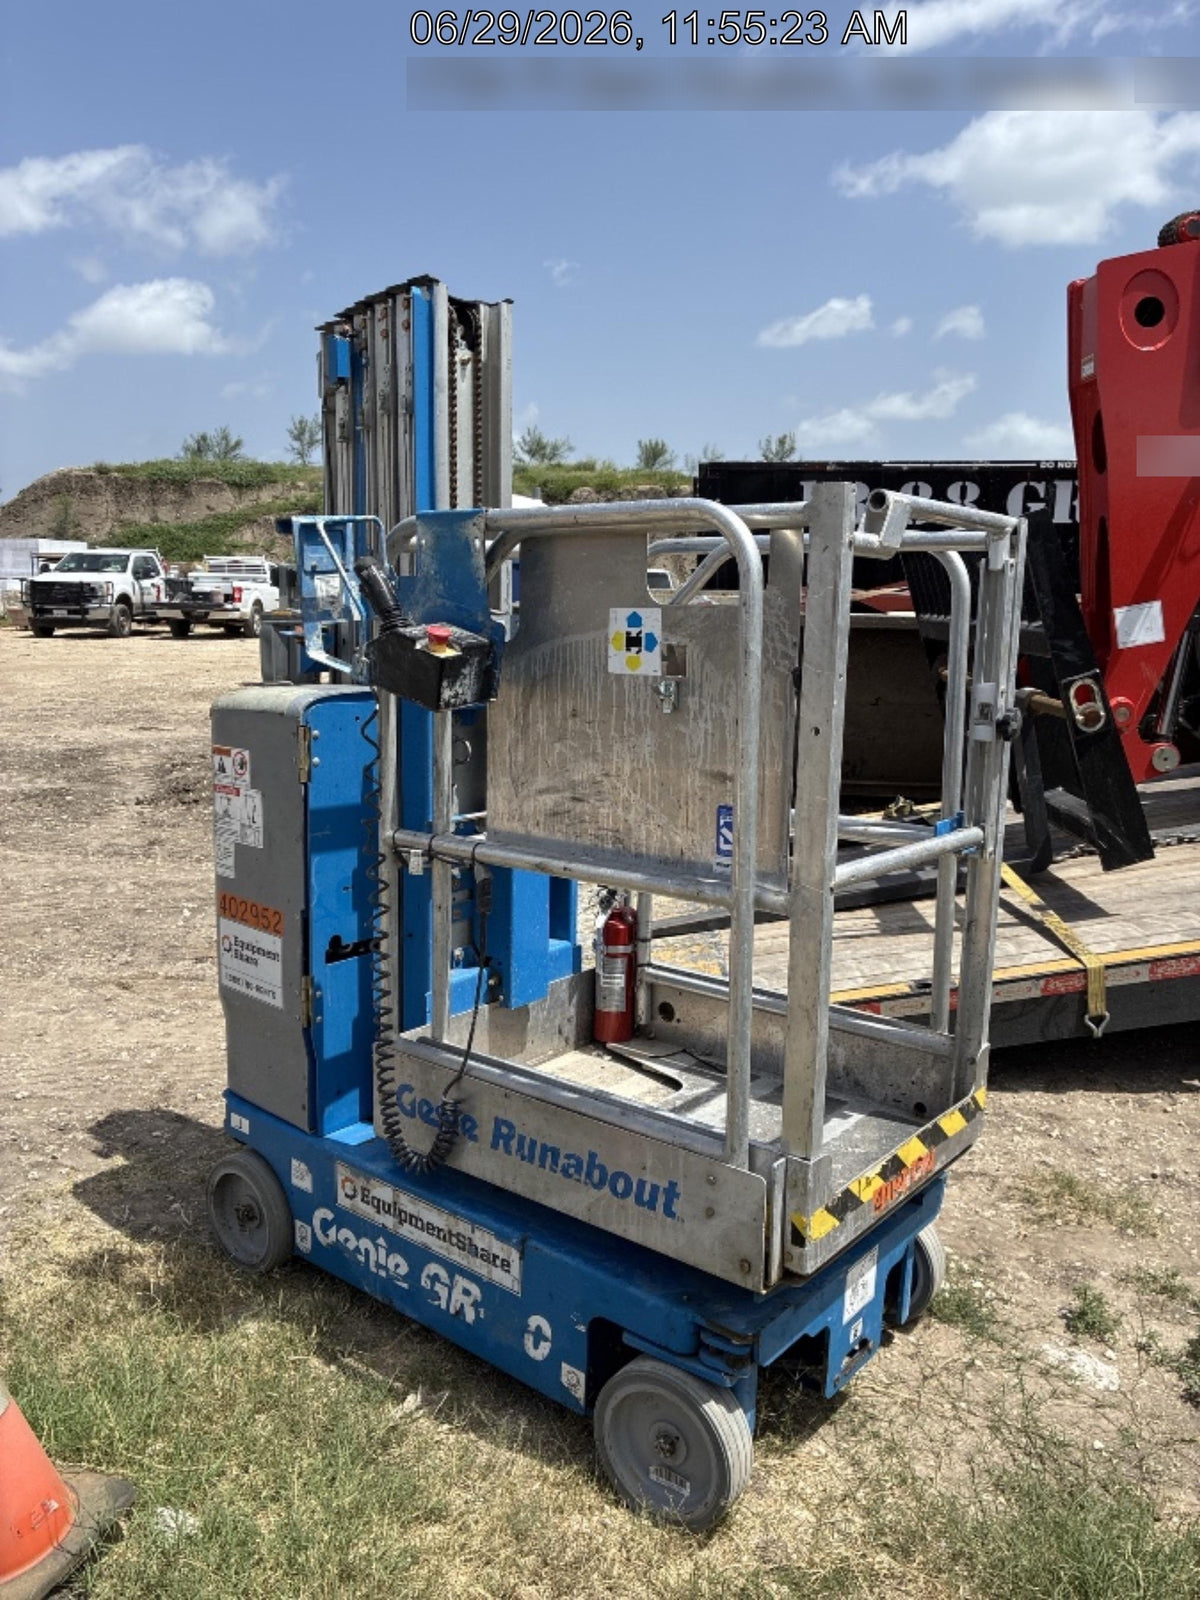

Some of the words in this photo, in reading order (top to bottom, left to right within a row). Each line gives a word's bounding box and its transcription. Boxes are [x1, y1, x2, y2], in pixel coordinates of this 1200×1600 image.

[1039, 461, 1055, 469] DO
[219, 893, 282, 935] 402952
[395, 1083, 479, 1143] Gee
[490, 1115, 681, 1220] Runabout
[312, 1207, 410, 1290] Genie
[360, 1184, 512, 1275] EquipmentShare
